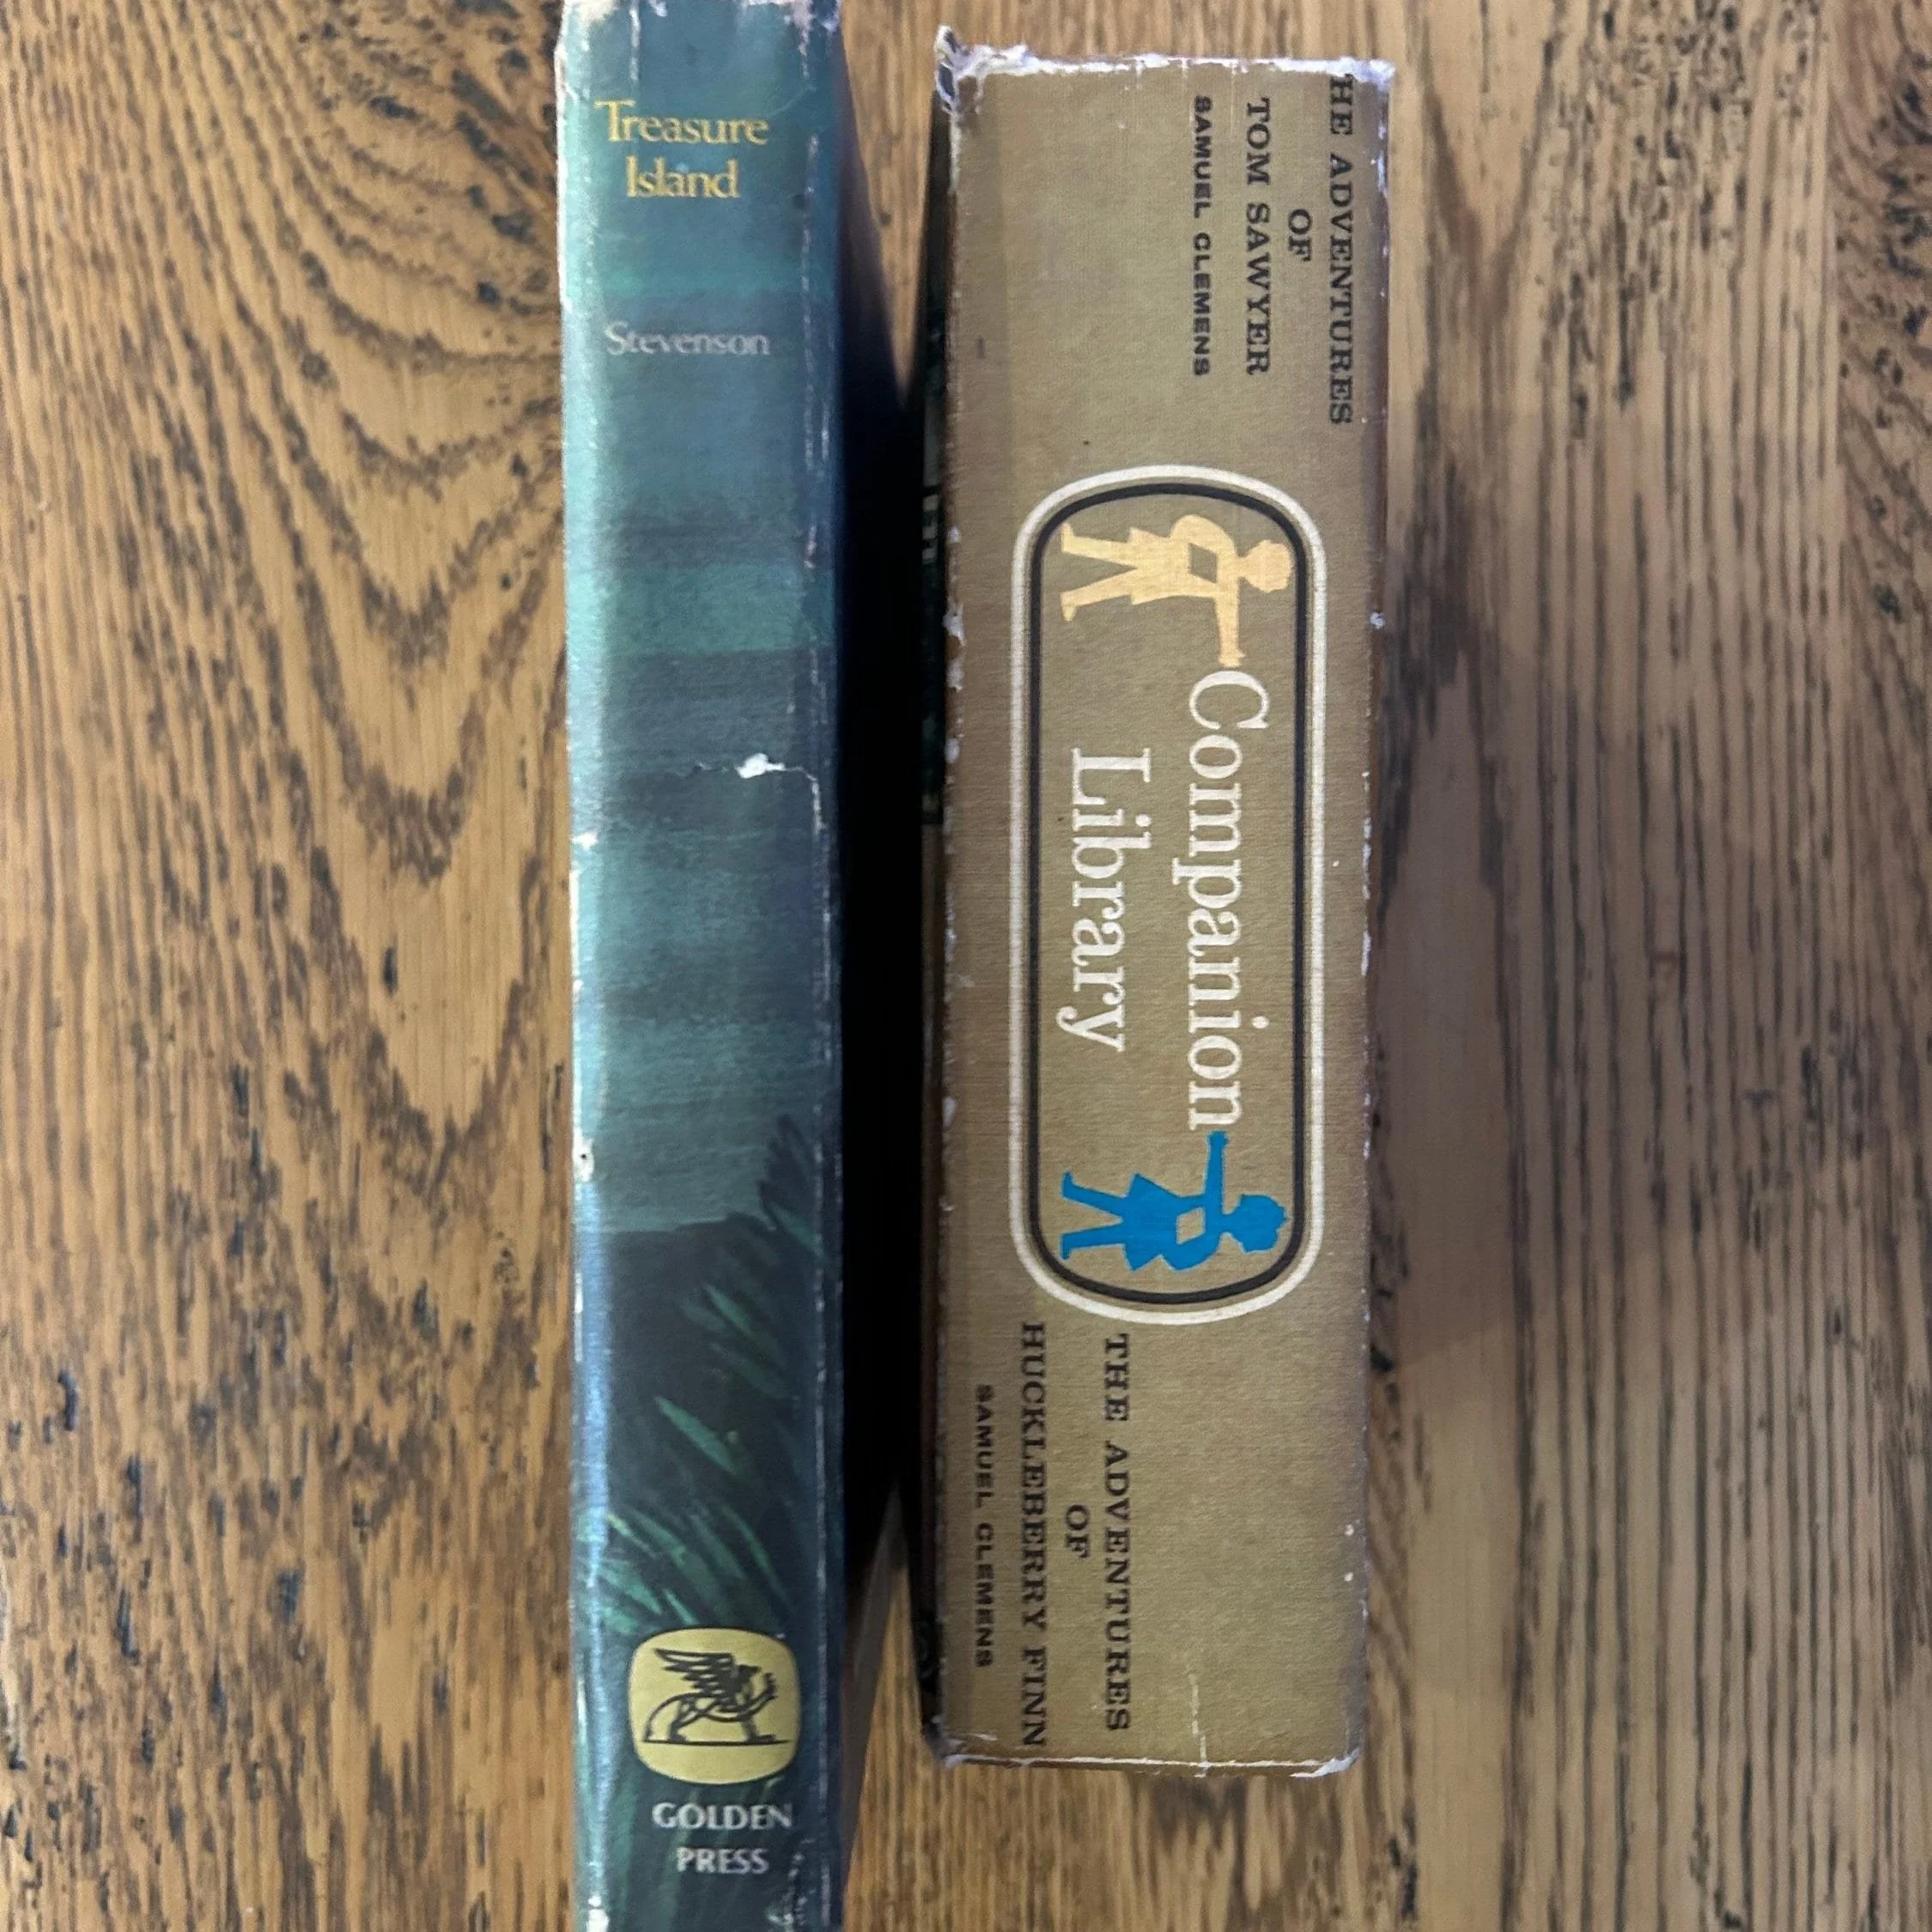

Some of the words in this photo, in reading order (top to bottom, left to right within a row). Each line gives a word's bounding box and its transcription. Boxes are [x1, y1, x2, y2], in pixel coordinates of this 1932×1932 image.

[594, 99, 769, 145] Treasure
[1246, 97, 1271, 185] TOM
[1329, 73, 1354, 135] HE
[625, 155, 741, 199] Island
[1193, 95, 1212, 218] SAMUEL
[1289, 208, 1314, 262] OF
[604, 320, 772, 355] Stevenson
[1193, 232, 1212, 376] CLEMENS
[1246, 203, 1271, 376] SAWYER
[1329, 153, 1354, 424] ADVENTURES
[1055, 747, 1151, 1052] Library
[1172, 670, 1270, 1132] Companion
[1104, 1333, 1130, 1422] THE
[975, 1384, 996, 1509] SAMUEL
[1021, 1321, 1048, 1631] HUCKLEBERRY
[1064, 1503, 1091, 1558] OF
[975, 1523, 994, 1668] CLEMENS
[1104, 1440, 1132, 1732] ADVENTURES
[1021, 1646, 1048, 1747] FINN
[651, 1802, 792, 1830] GOLDEN
[676, 1847, 769, 1874] PRESS
